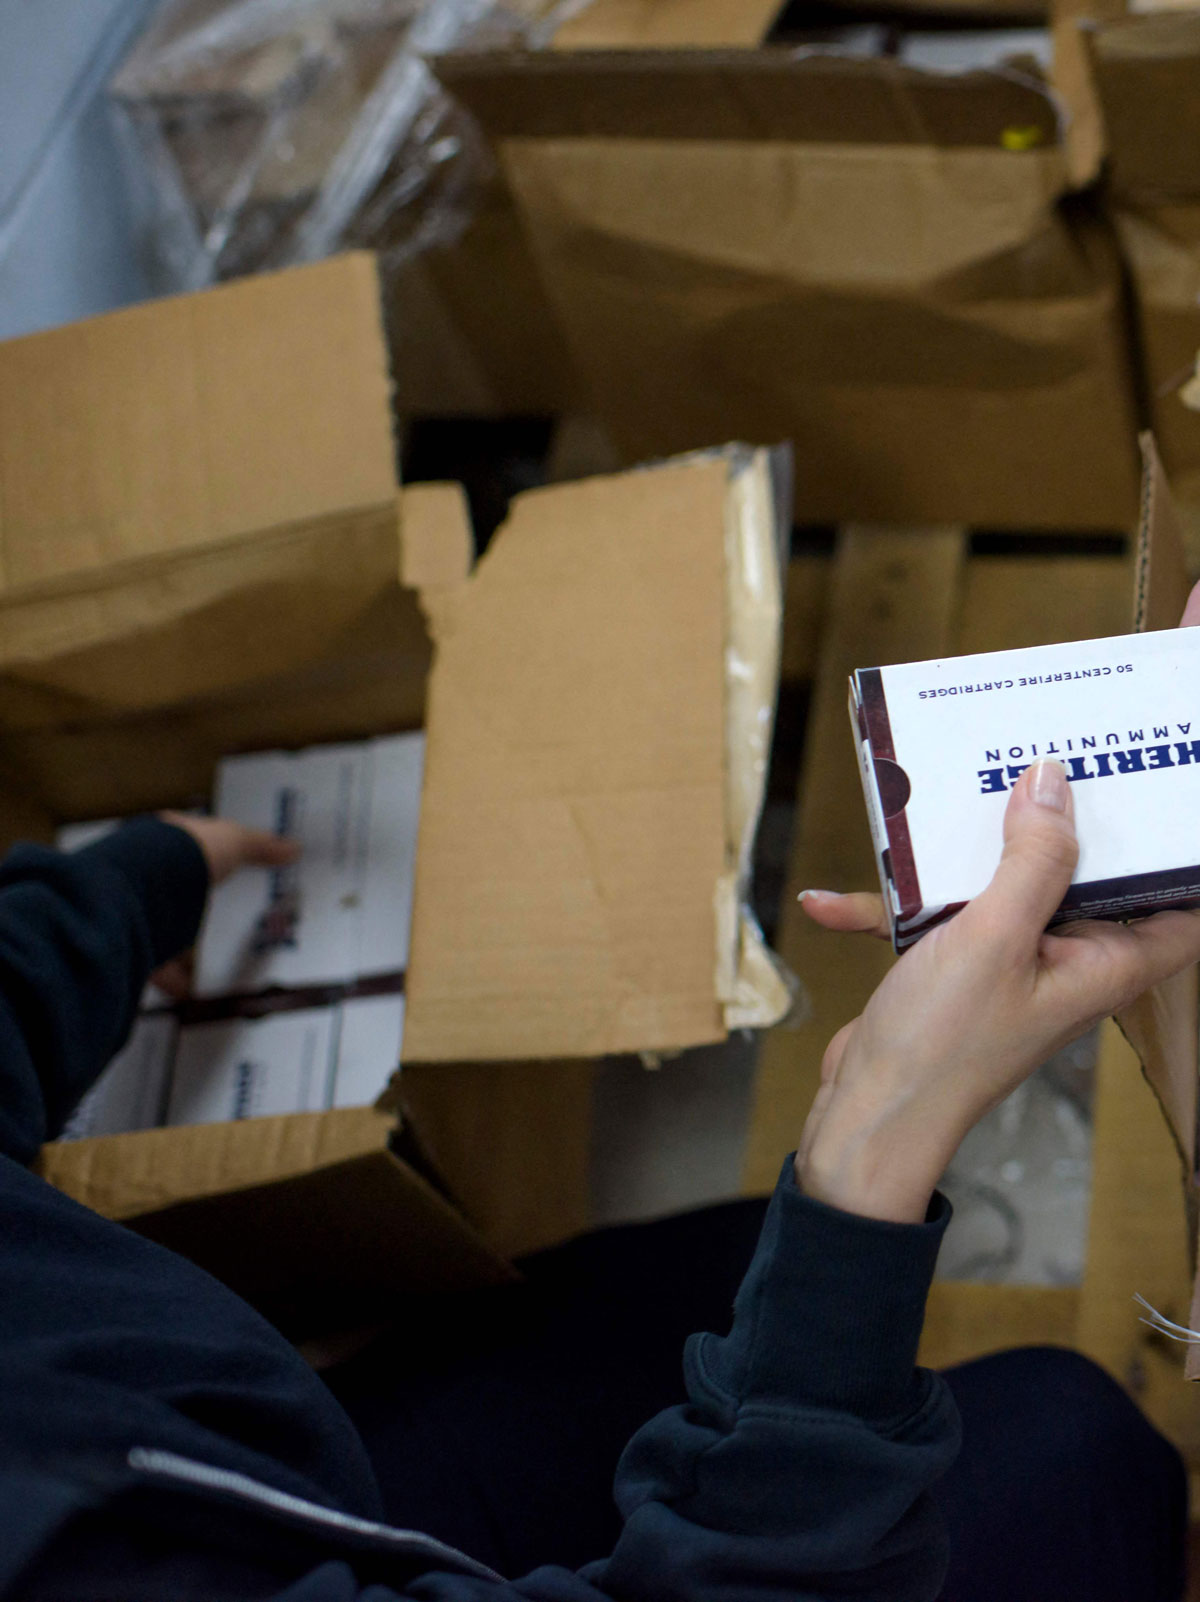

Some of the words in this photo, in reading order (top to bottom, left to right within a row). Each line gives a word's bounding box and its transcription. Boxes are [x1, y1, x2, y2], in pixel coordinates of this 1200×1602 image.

[1018, 665, 1112, 687] CENTERFIRE
[1116, 663, 1134, 674] 50
[918, 679, 1014, 700] CARTRIDGES
[985, 722, 1192, 763] AMMUNITION
